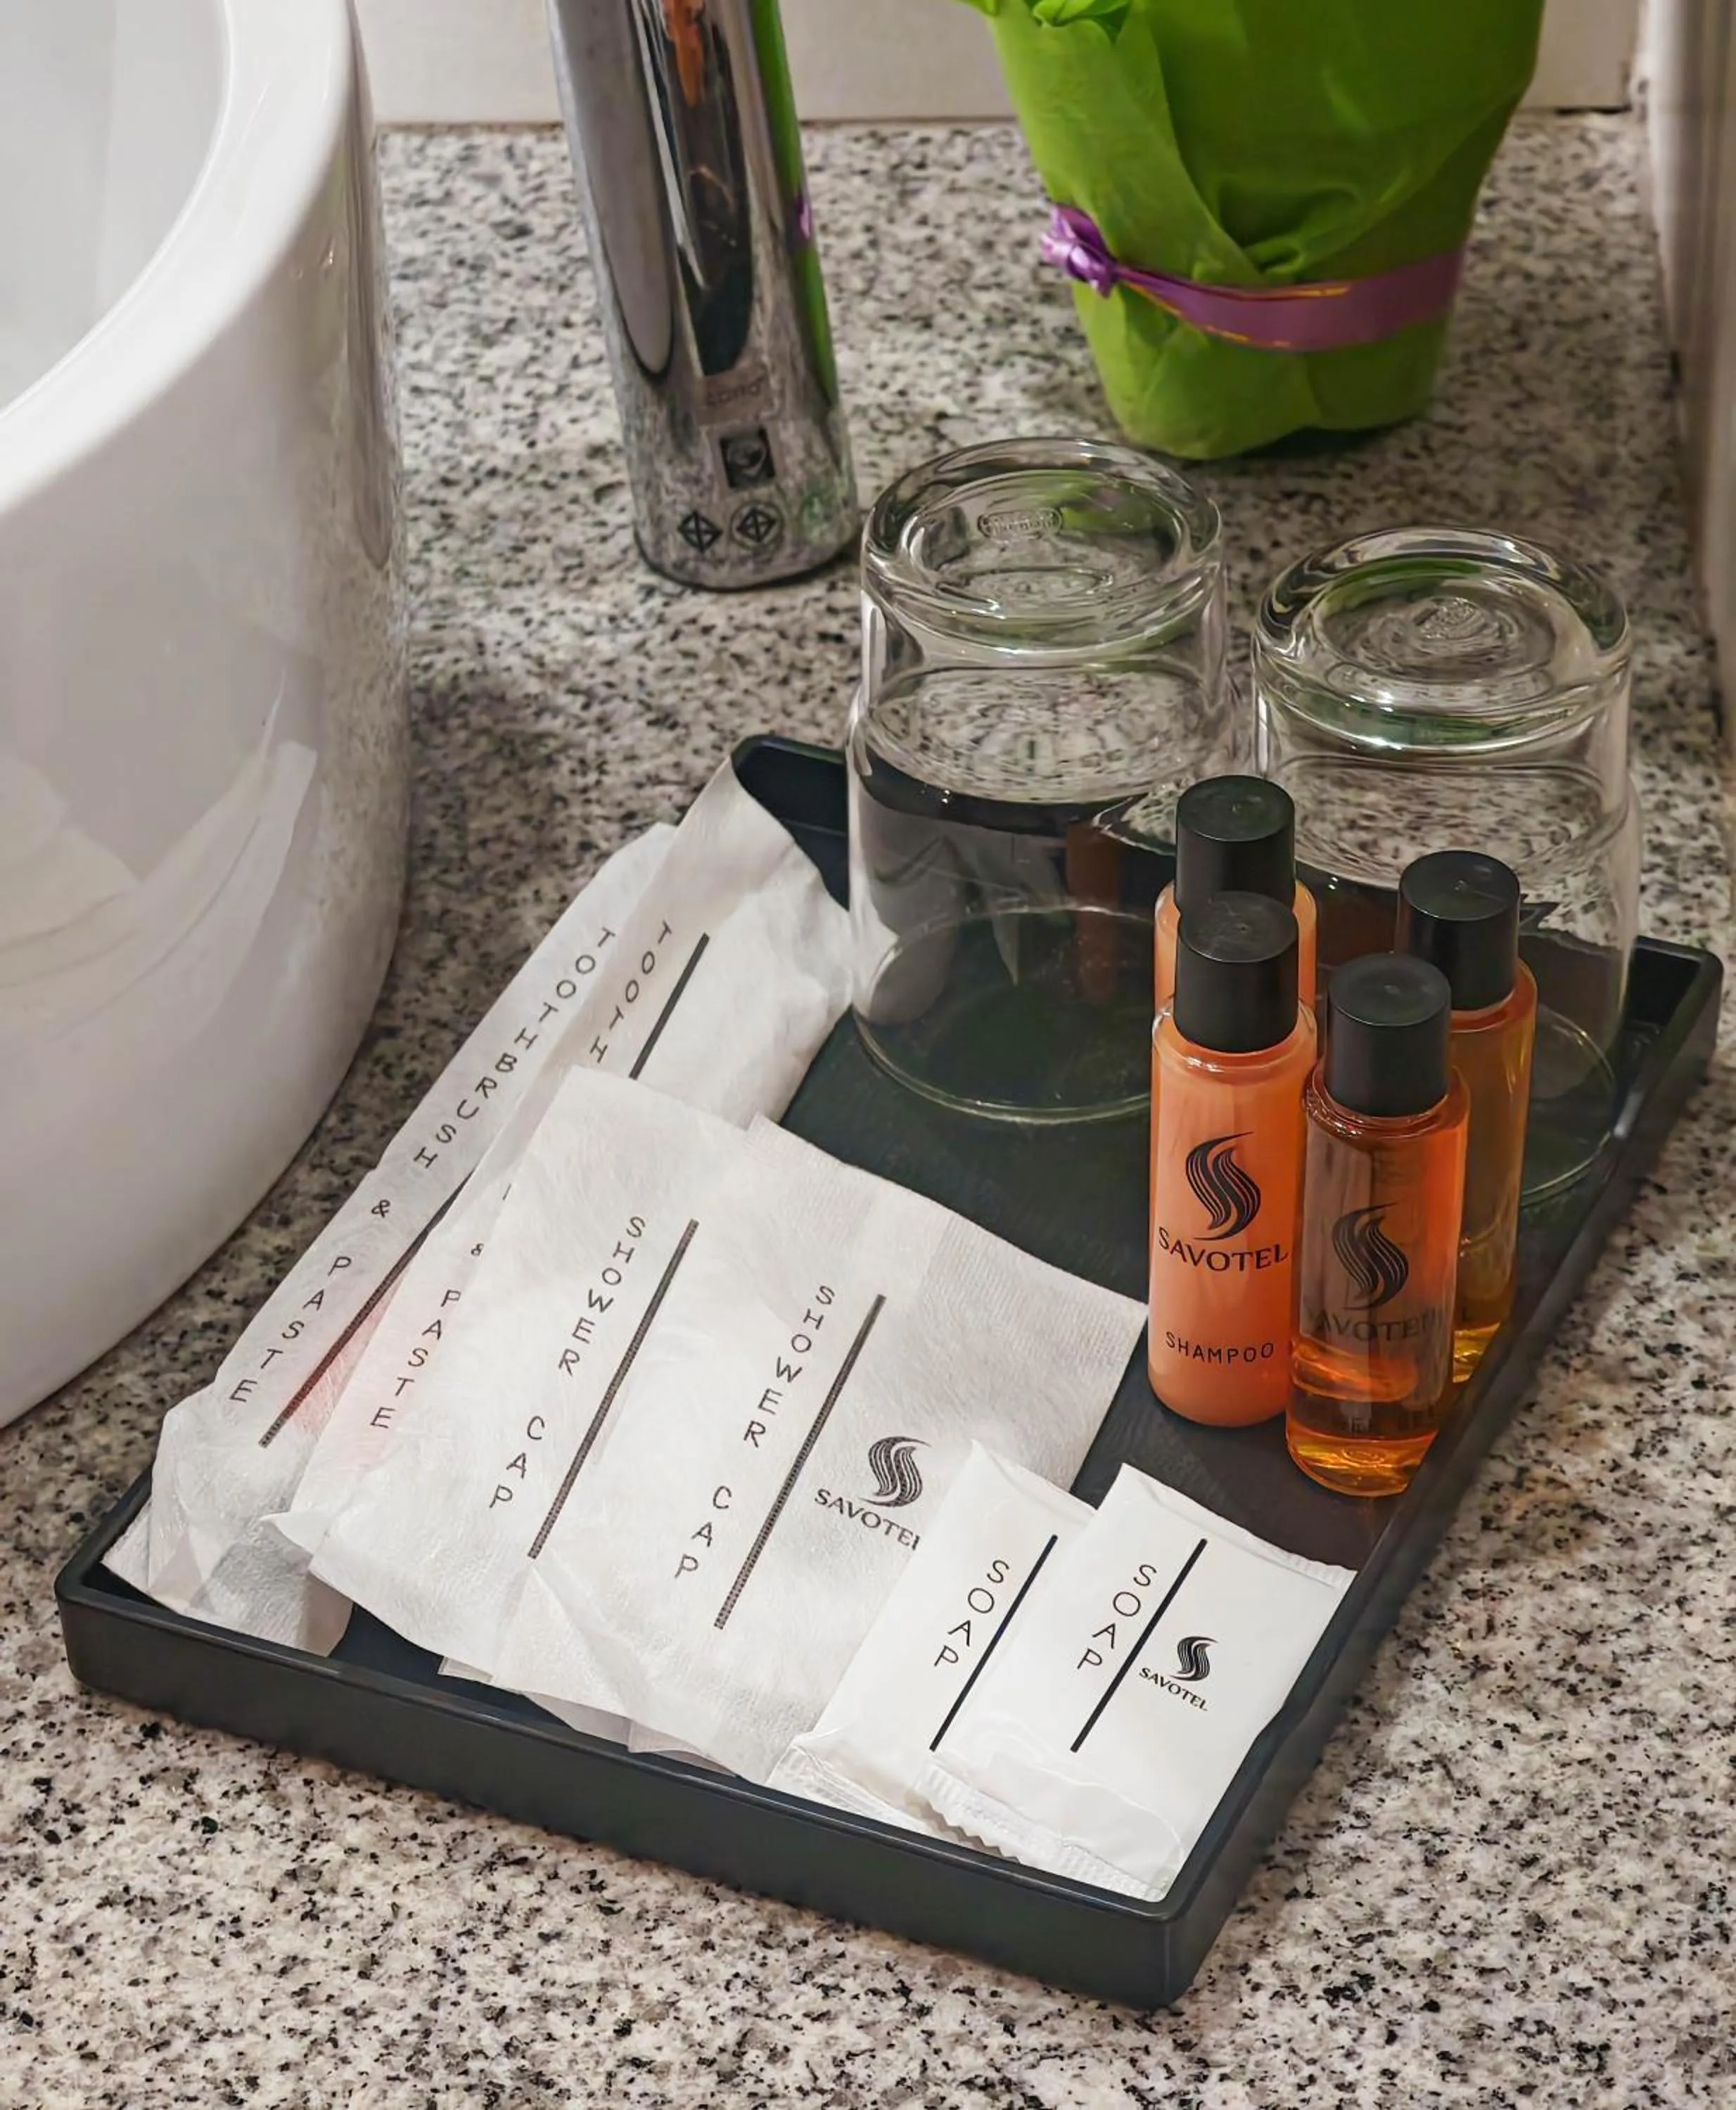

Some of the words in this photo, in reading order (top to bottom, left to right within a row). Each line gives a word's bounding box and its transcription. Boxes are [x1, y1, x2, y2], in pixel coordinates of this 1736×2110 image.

[589, 920, 672, 1063] TOOTH
[414, 926, 616, 1169] TOOTHBRUSH
[371, 1198, 391, 1218] &
[1159, 1227, 1289, 1272] SAVOTEL
[230, 1256, 351, 1403] PASTE
[558, 1216, 646, 1376] SHOWER
[1166, 1331, 1274, 1364] SHAMPOO
[1310, 1307, 1437, 1342] AVOTE
[371, 1290, 461, 1429] PASTE
[743, 1285, 836, 1447] SHOWER
[490, 1416, 545, 1509] CAP
[675, 1485, 732, 1578] CAP
[933, 1559, 1010, 1668] SOAP
[1077, 1564, 1157, 1671] SOAP
[1138, 1667, 1208, 1711] SAVOTEL
